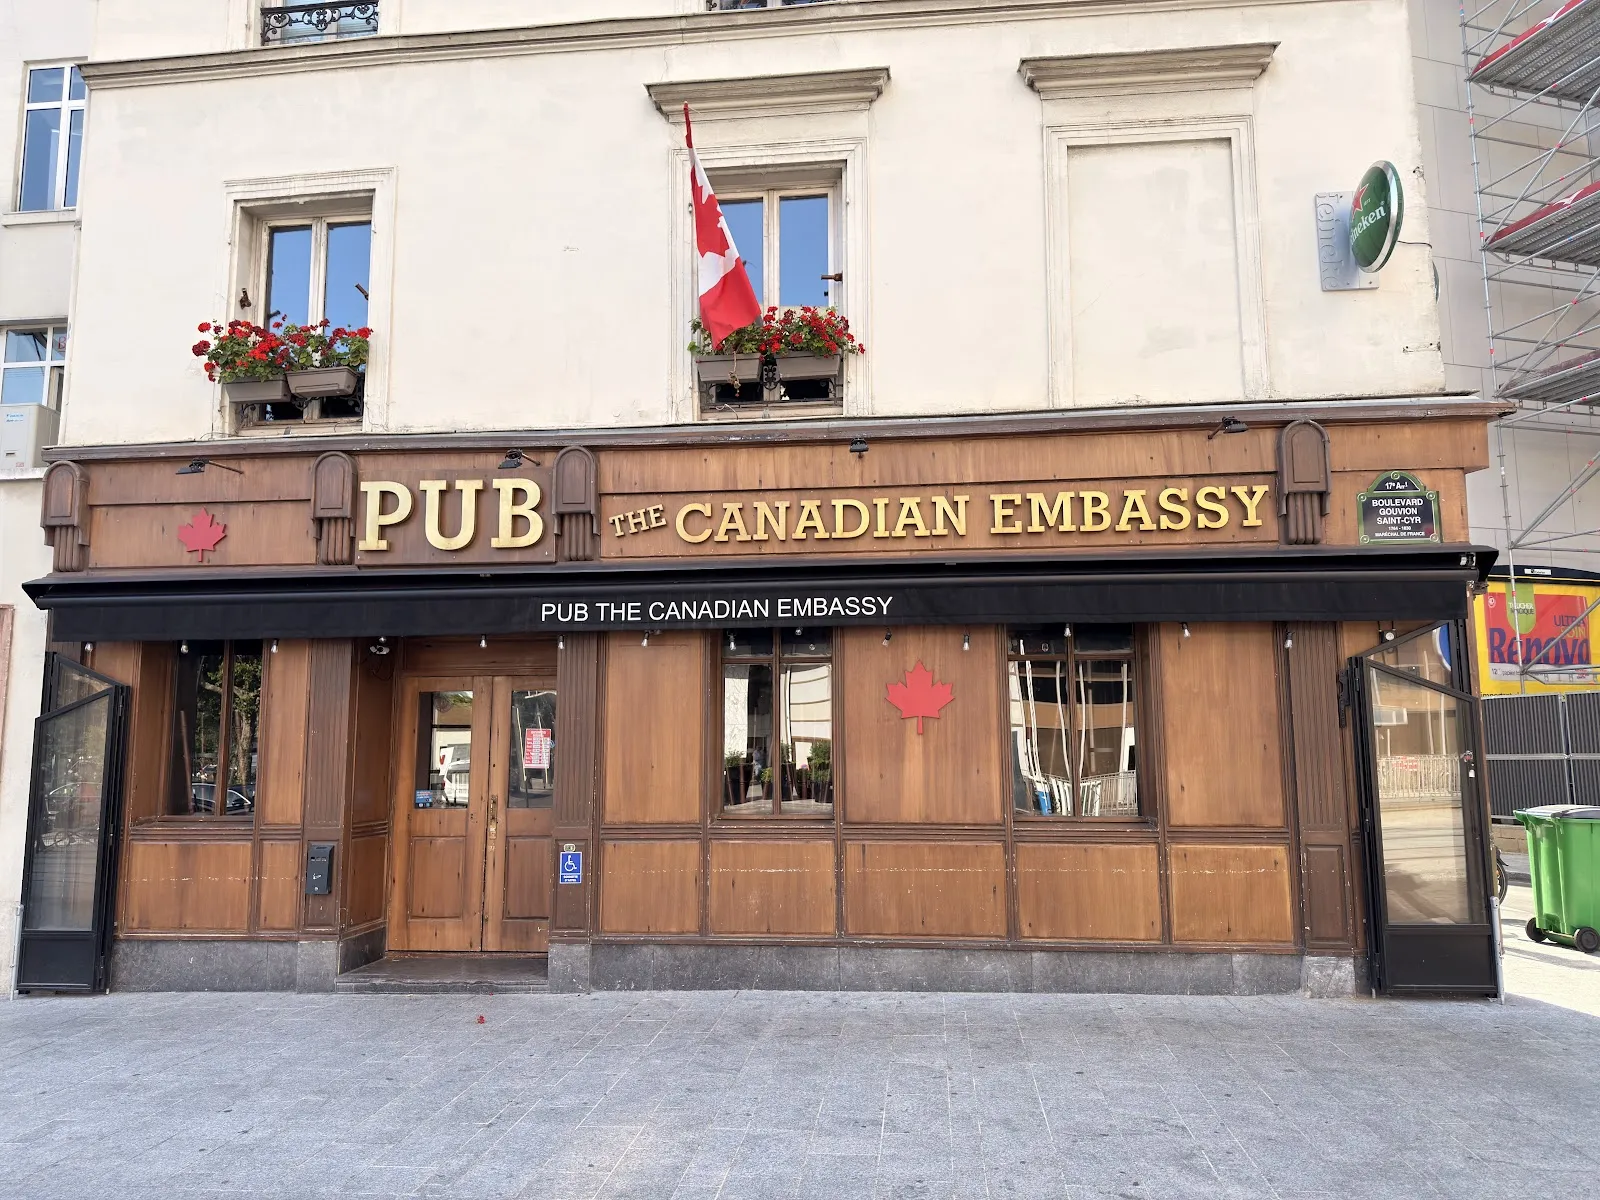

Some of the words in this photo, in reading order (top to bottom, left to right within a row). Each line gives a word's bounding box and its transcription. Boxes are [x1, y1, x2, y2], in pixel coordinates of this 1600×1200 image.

[1351, 205, 1387, 245] ineken
[358, 478, 544, 551] PUB
[608, 503, 667, 537] THE
[675, 494, 970, 544] CANADIAN
[989, 484, 1270, 535] EMBASSY
[1372, 499, 1423, 507] BOULEVARD
[1376, 517, 1421, 525] SAINT-CYR
[541, 602, 590, 622] PUB
[598, 601, 642, 621] THE
[648, 598, 770, 621] CANADIAN
[777, 595, 894, 618] EMBASSY
[1553, 614, 1585, 627] ULTRA
[1489, 627, 1590, 666] Renova
